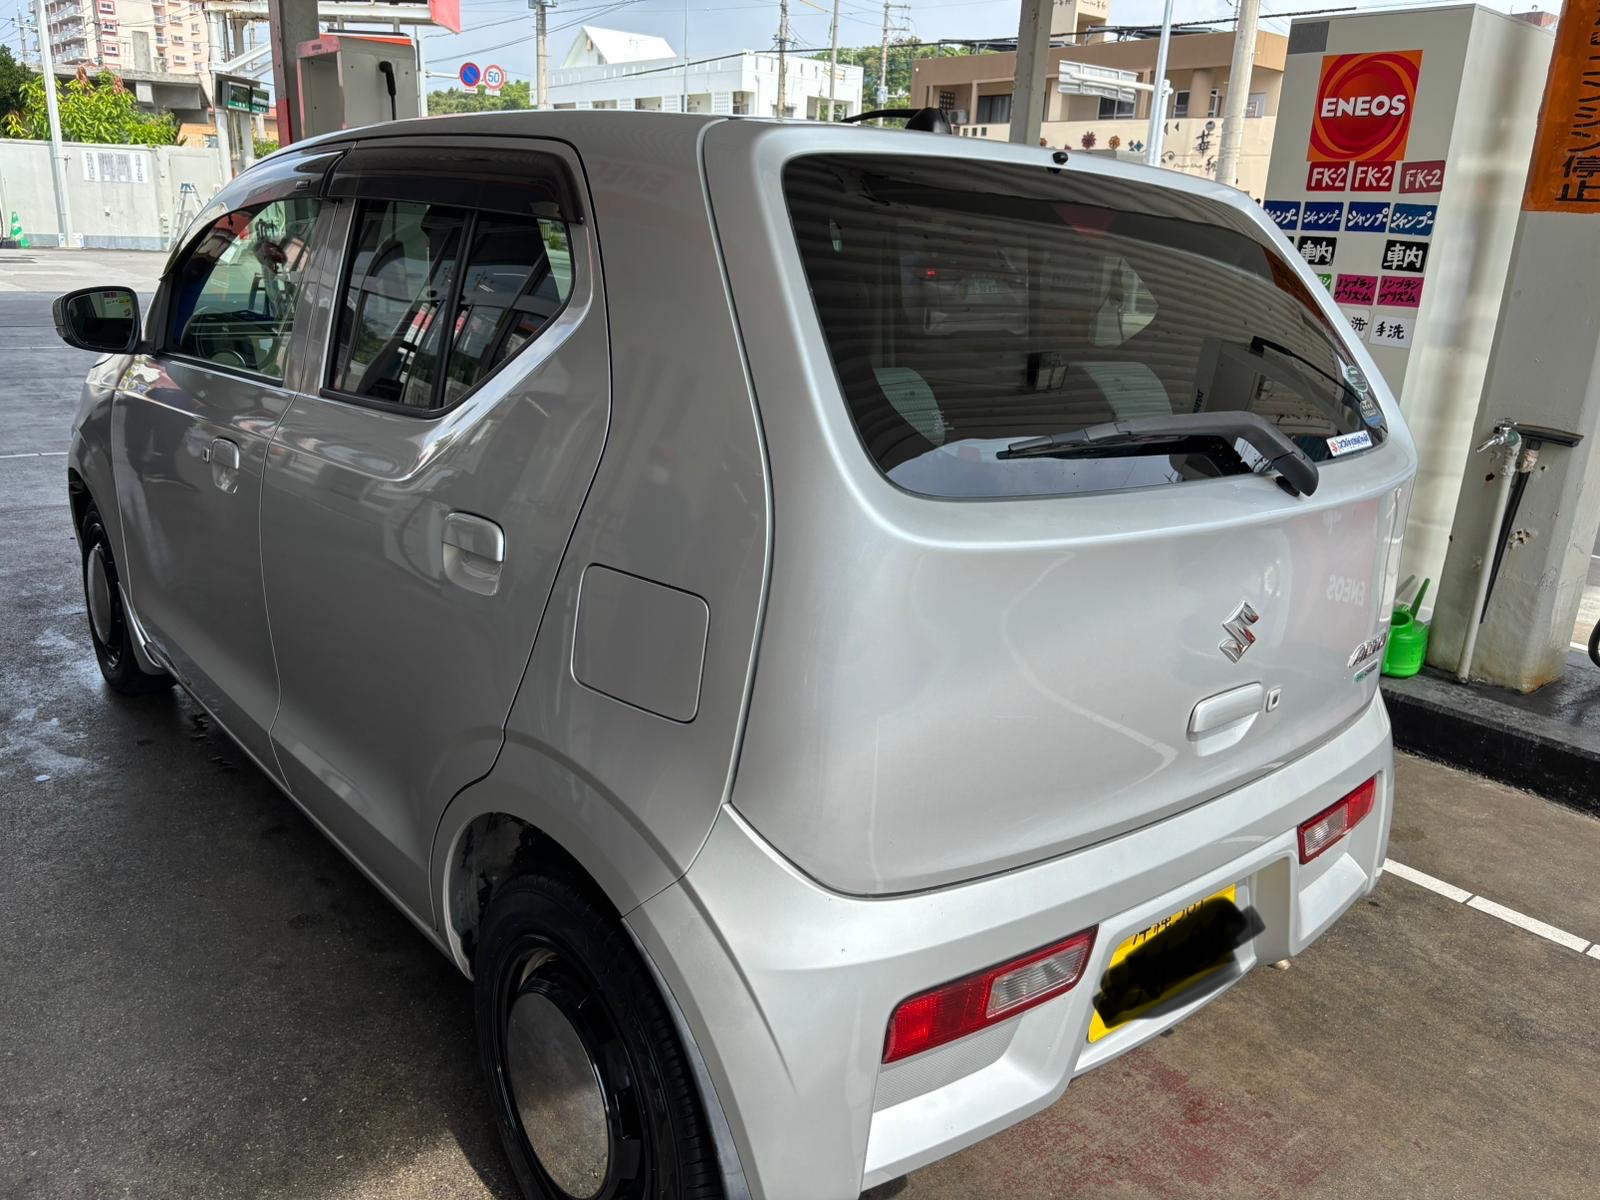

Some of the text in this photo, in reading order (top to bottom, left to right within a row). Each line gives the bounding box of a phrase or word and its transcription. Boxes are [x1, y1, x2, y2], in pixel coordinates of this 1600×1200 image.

[488, 71, 500, 83] 50
[1321, 95, 1406, 117] ENEOS
[1311, 167, 1346, 188] FK-2
[1354, 166, 1393, 188] FK-2
[1405, 169, 1442, 190] FK-2
[1303, 209, 1342, 225] シャンプー
[1347, 207, 1388, 227] シャンプー
[1391, 211, 1434, 230] シャンプー
[1300, 240, 1333, 263] 車内
[1383, 243, 1423, 269] 車内
[1375, 320, 1404, 339] 手洗
